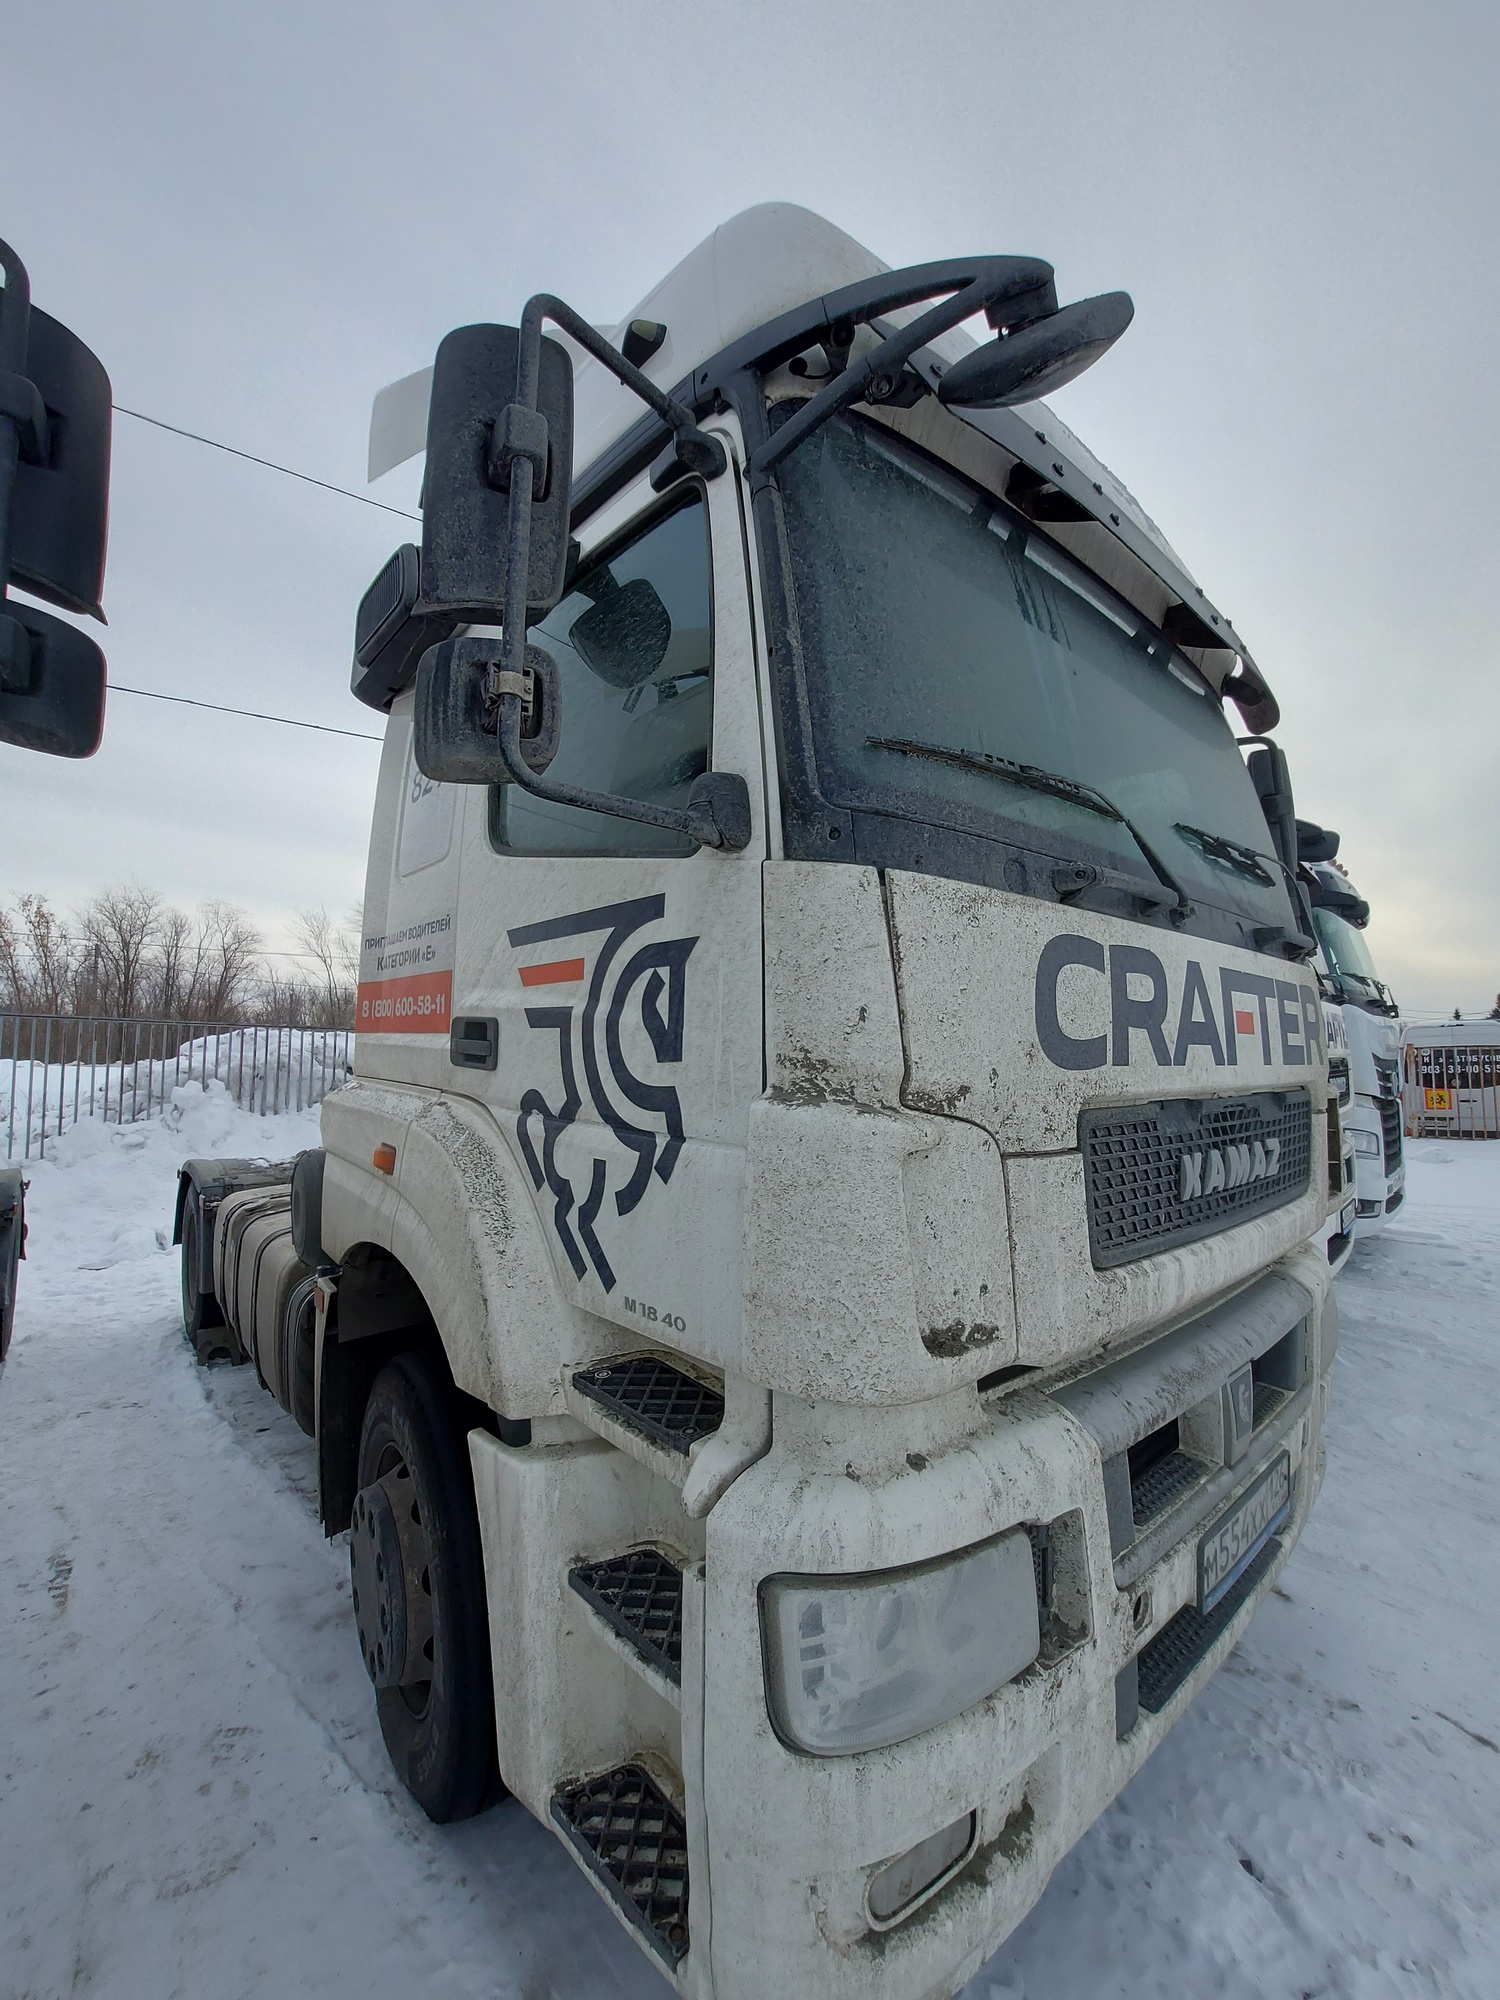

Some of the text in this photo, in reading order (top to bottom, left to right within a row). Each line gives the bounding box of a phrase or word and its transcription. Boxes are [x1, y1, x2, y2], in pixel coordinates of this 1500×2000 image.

[408, 914, 451, 940] ВОДИТЕЛЕЙ
[377, 947, 420, 972] КАТЕГОРИИ
[361, 993, 446, 1020] 8 (800) 600-58-11
[1035, 933, 1325, 1071] CRAFTER
[1180, 1138, 1280, 1201] KAMAZ
